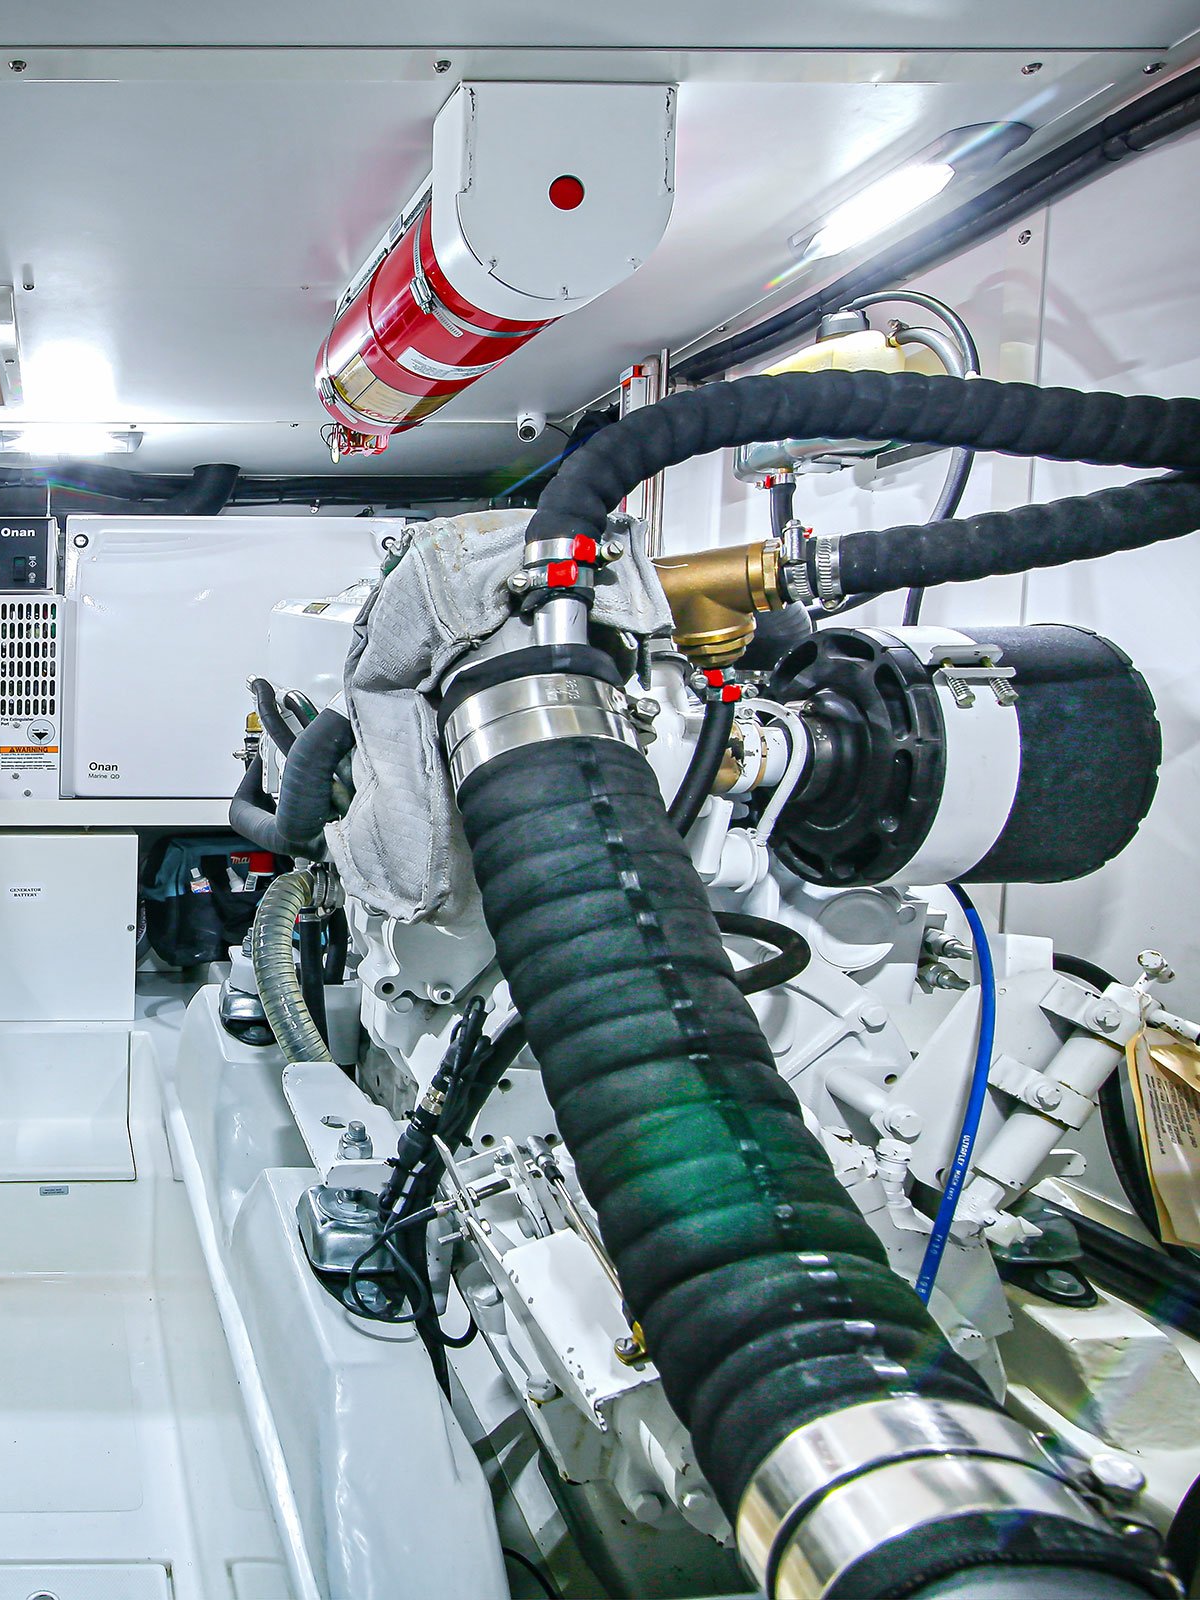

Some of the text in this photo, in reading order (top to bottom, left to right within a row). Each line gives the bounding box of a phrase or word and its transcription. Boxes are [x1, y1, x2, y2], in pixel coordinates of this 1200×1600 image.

[0, 527, 36, 538] Onan
[15, 746, 49, 754] WARNING
[89, 761, 119, 772] Onan
